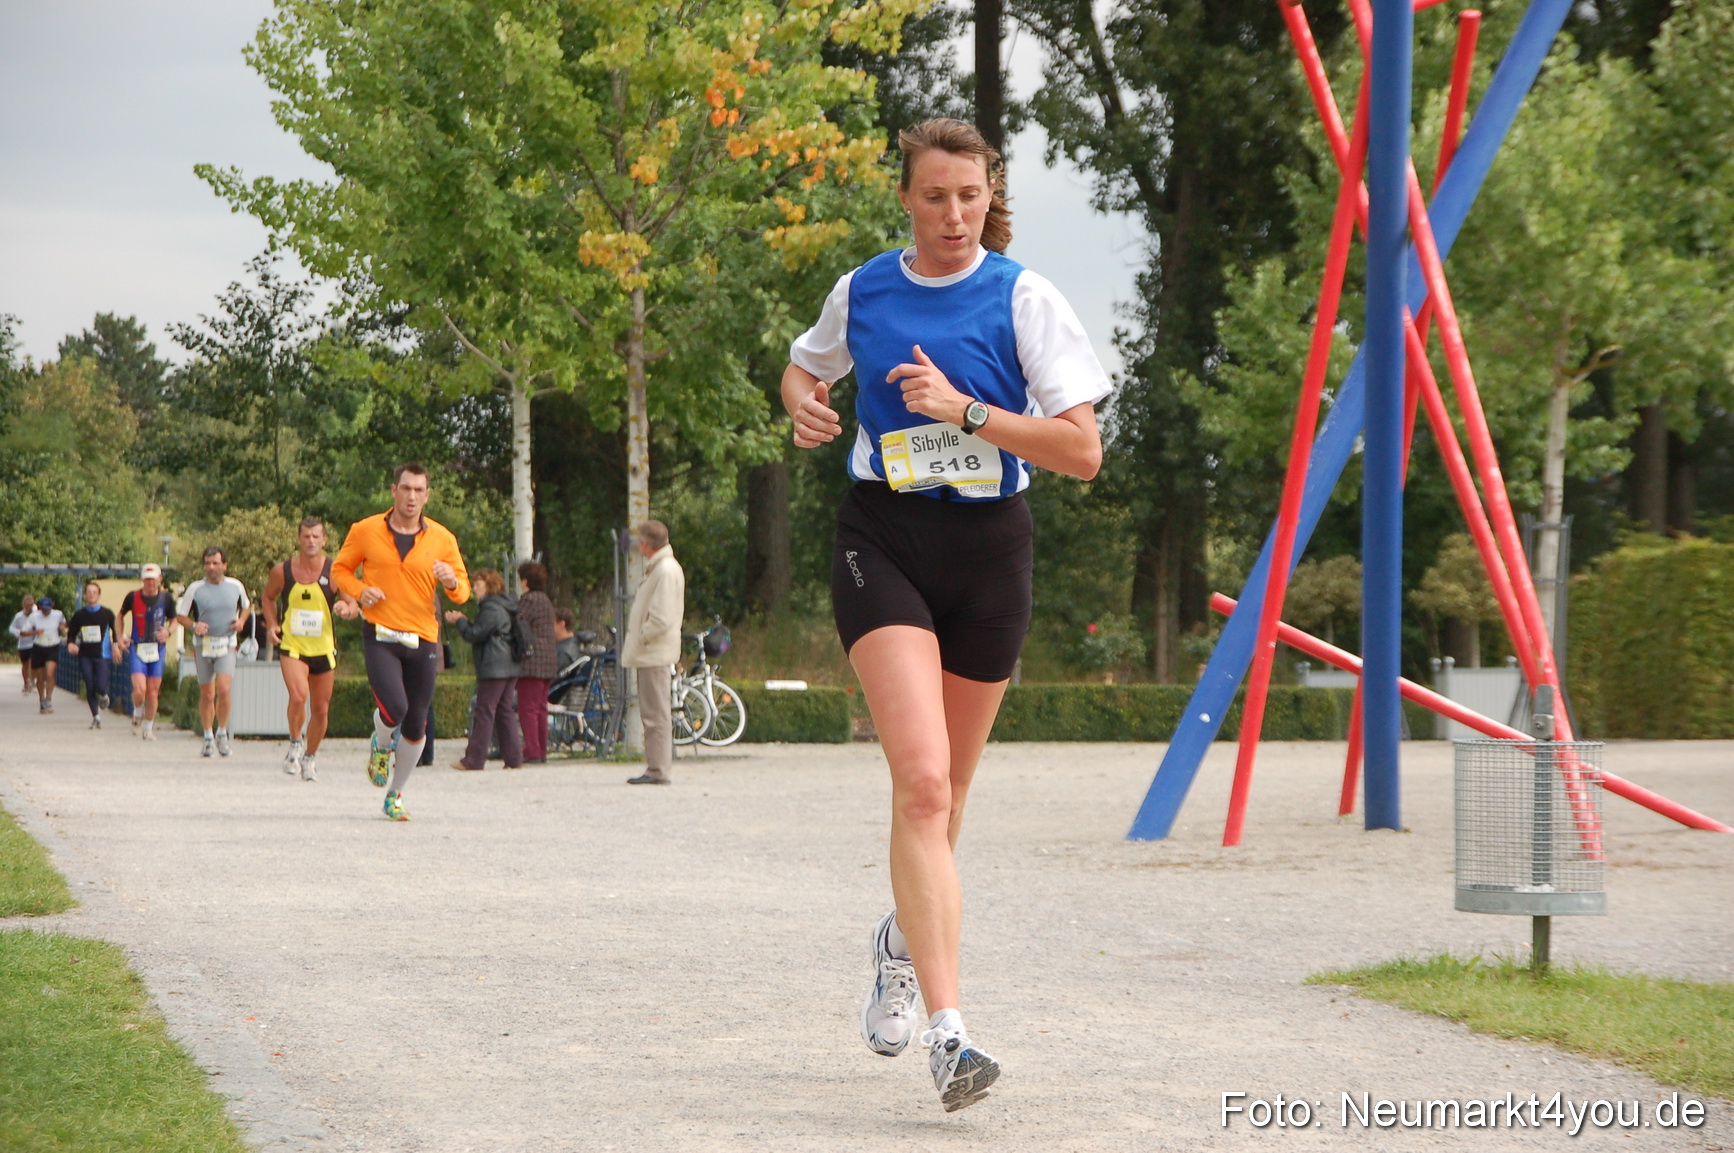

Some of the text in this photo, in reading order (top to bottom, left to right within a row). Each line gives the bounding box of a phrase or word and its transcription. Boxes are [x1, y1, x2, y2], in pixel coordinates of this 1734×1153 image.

[911, 430, 960, 453] Sibylle
[891, 465, 898, 474] A
[929, 454, 982, 474] 518
